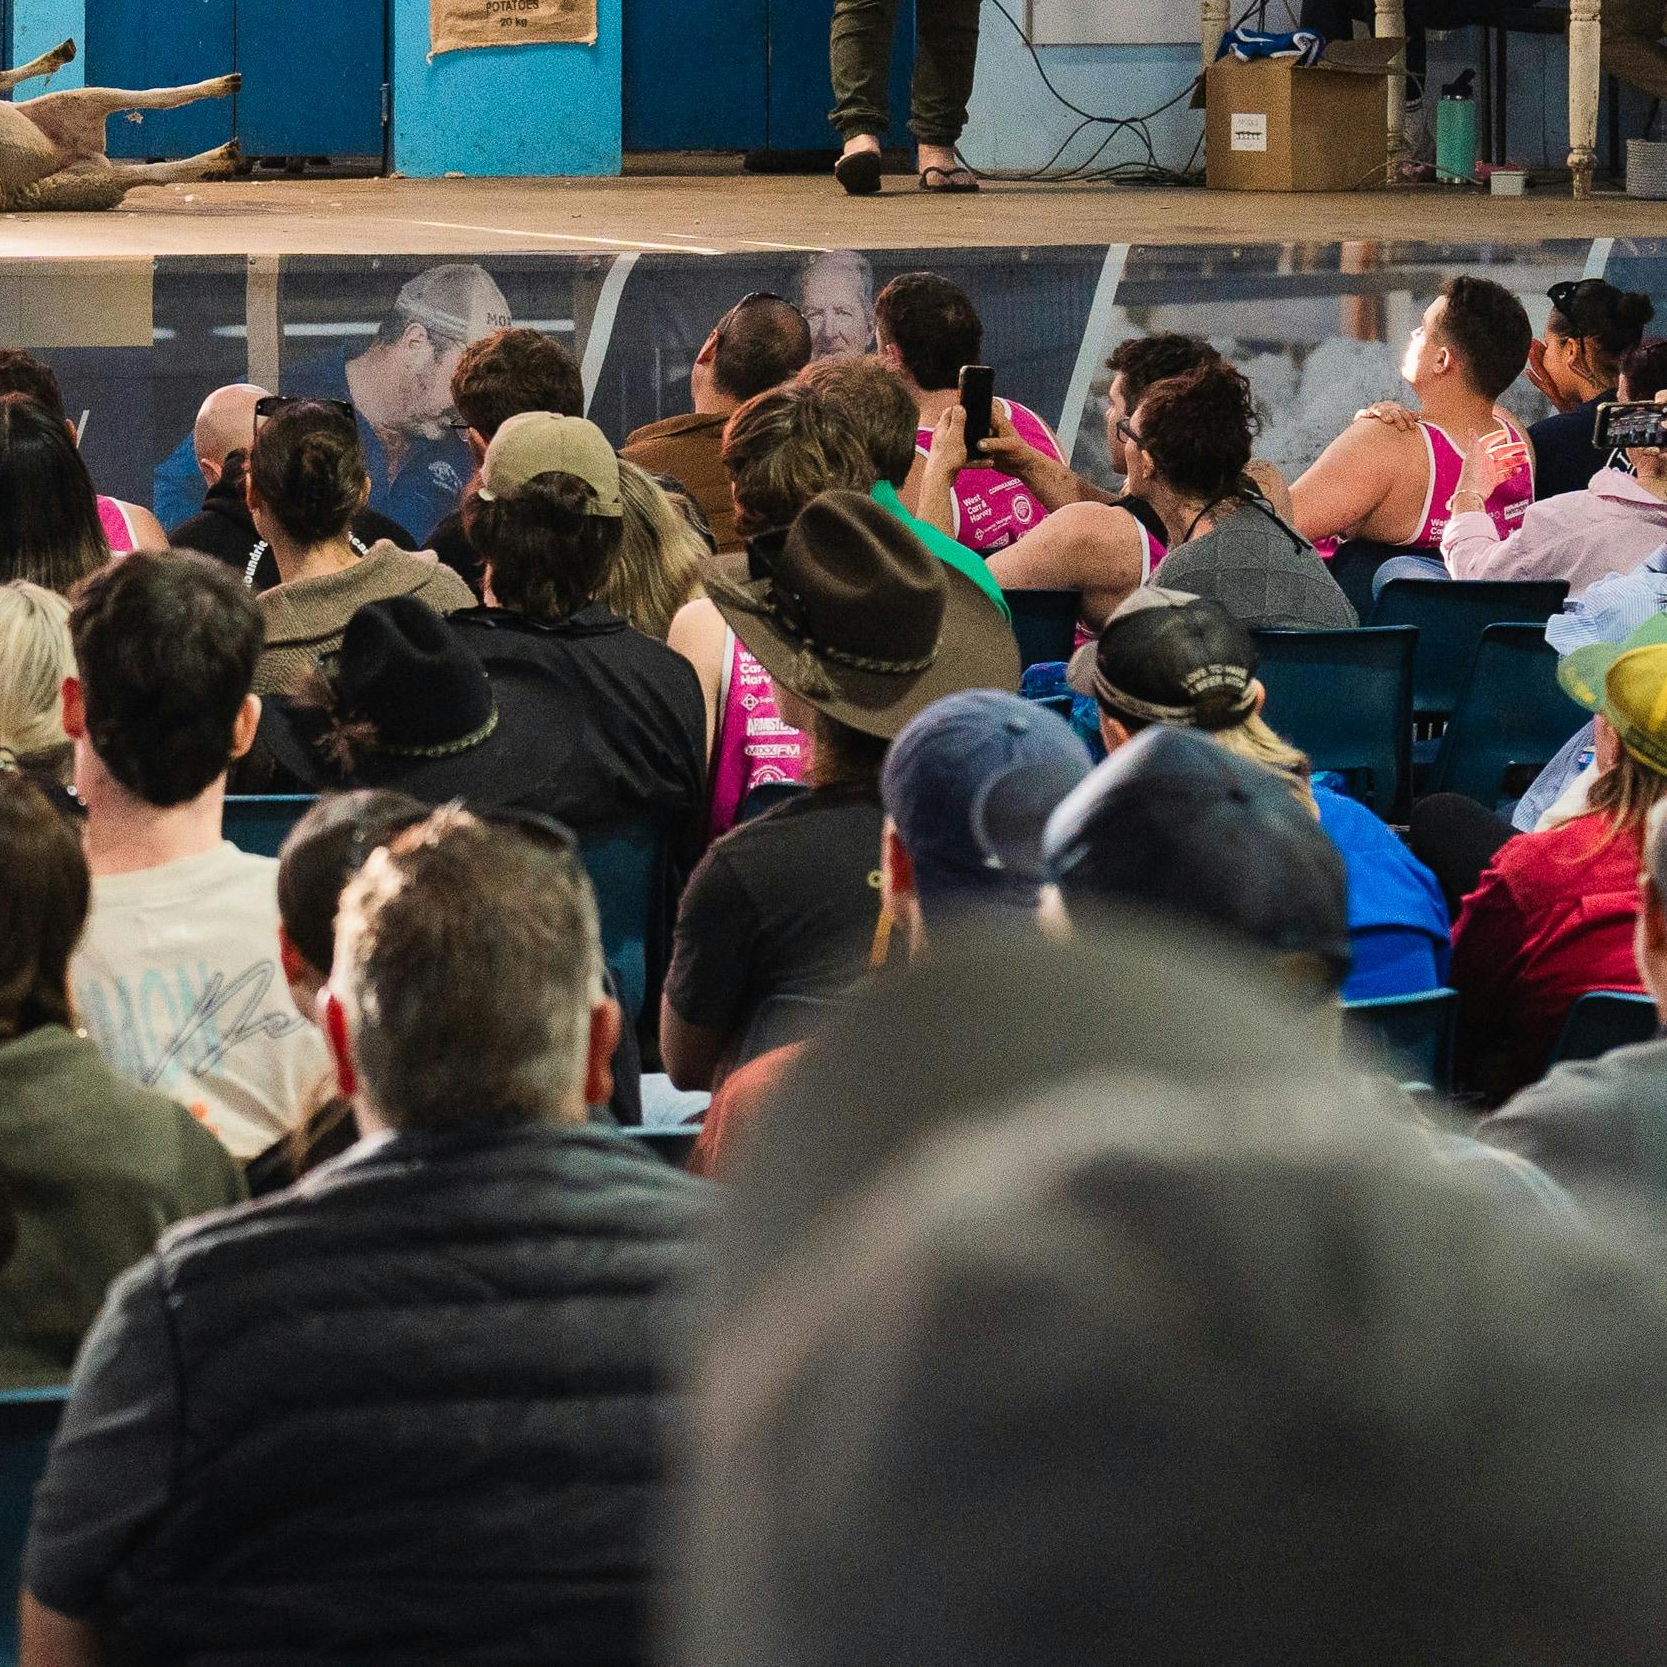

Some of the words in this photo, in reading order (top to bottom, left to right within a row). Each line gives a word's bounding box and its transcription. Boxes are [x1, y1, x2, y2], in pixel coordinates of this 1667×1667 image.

[500, 18, 513, 27] 20
[515, 17, 528, 28] kg
[963, 495, 982, 508] West
